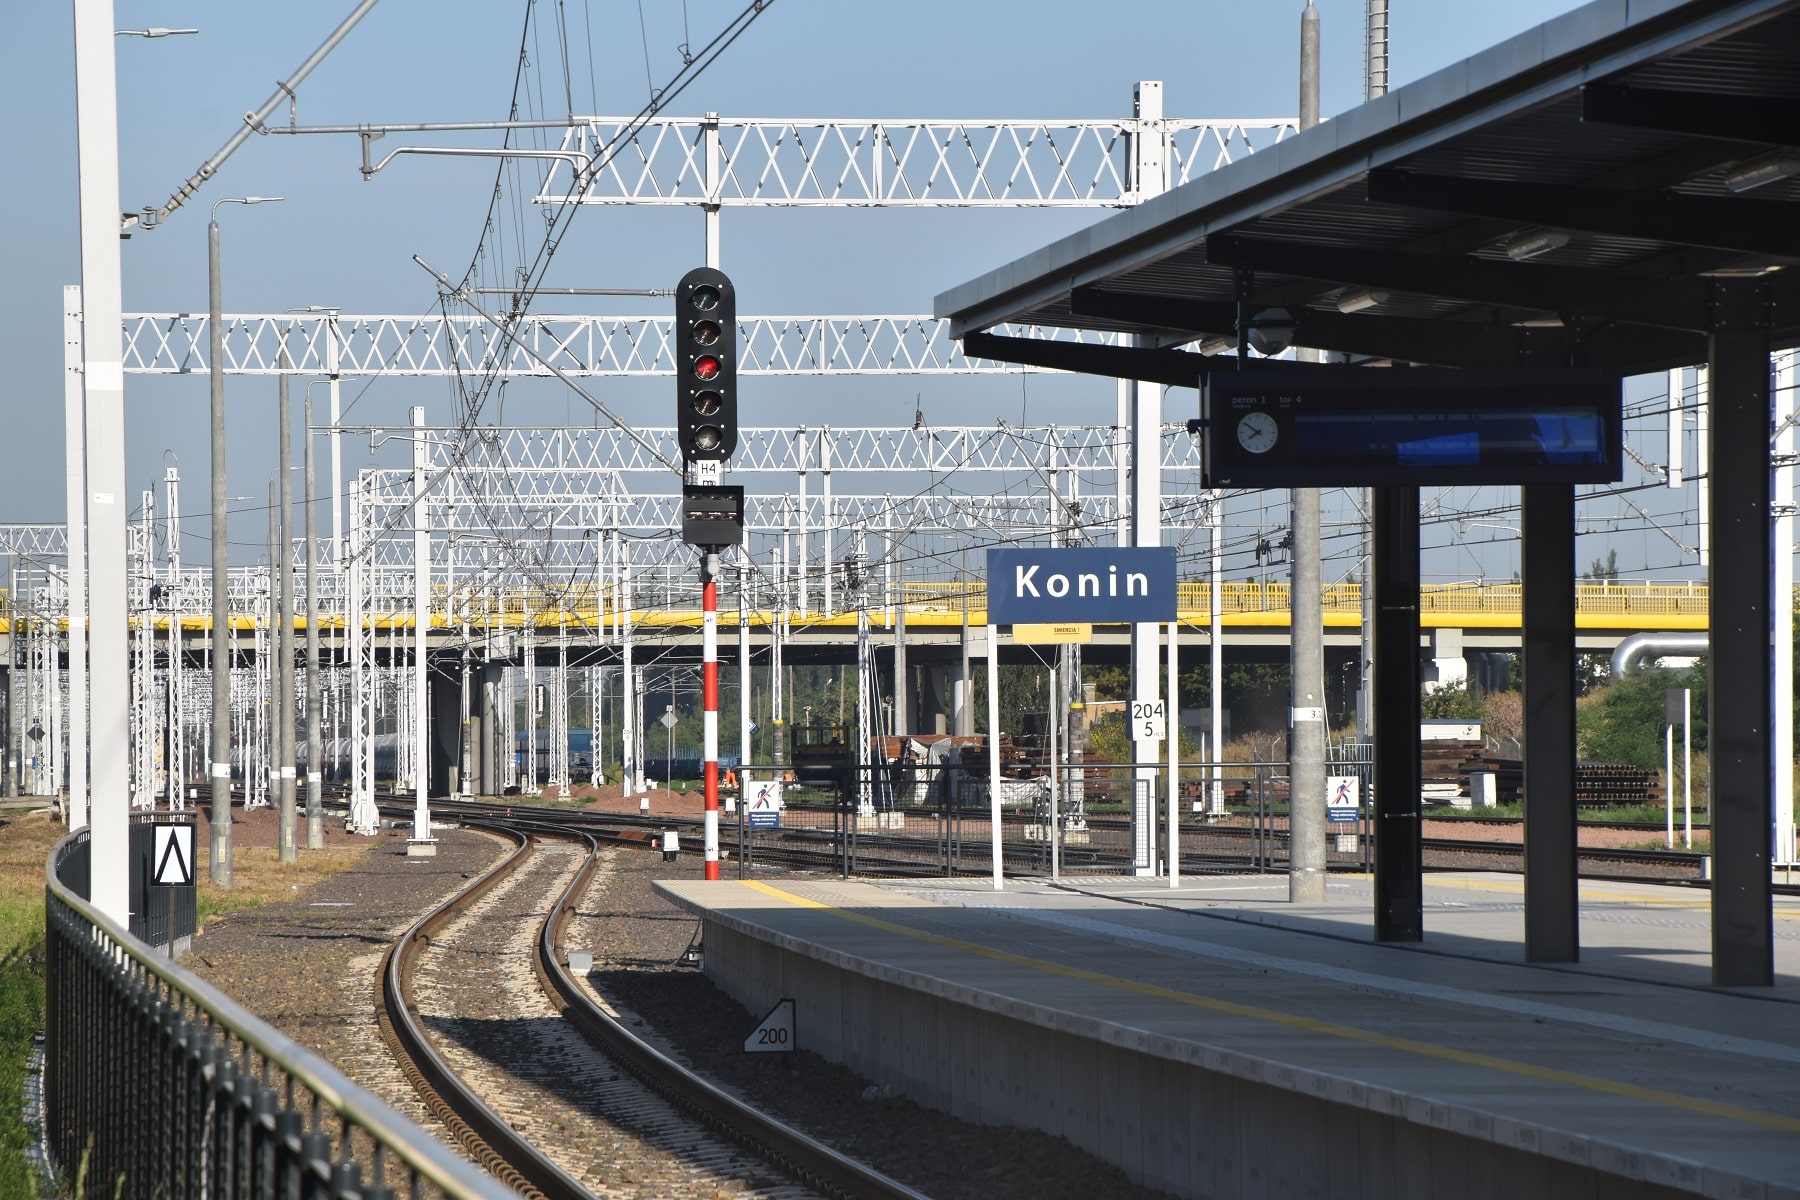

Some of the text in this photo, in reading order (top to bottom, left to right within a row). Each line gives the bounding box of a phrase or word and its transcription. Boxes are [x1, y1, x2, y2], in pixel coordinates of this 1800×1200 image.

[1232, 396, 1257, 405] peron
[1279, 396, 1292, 404] tor
[701, 463, 716, 474] H4
[1016, 565, 1148, 598] Konin
[1133, 703, 1163, 719] 204
[1144, 721, 1153, 737] 5
[758, 1027, 788, 1045] 200
